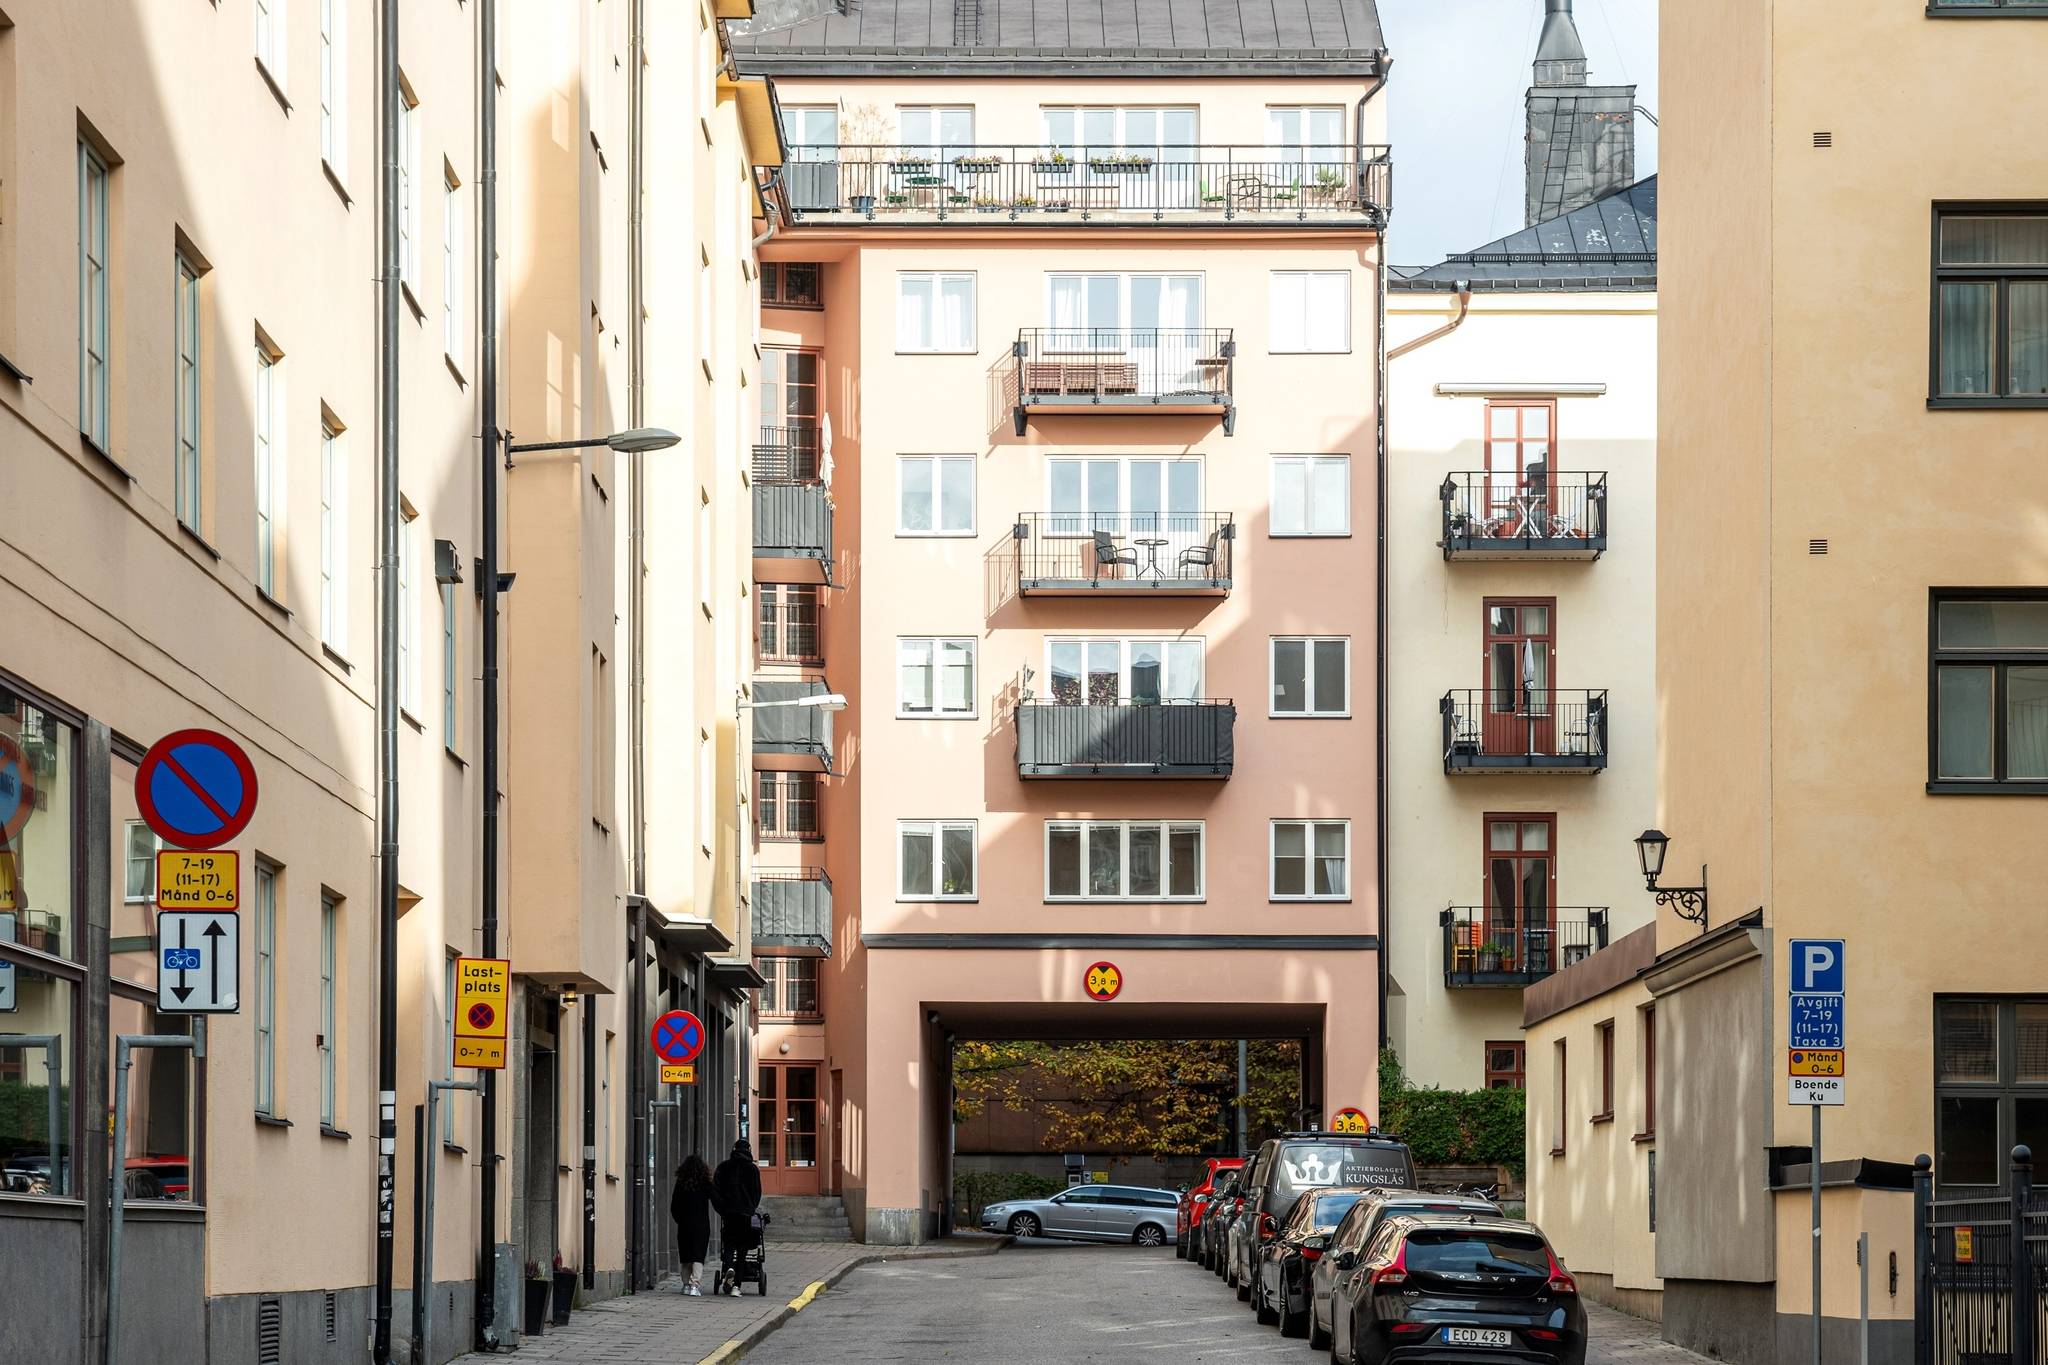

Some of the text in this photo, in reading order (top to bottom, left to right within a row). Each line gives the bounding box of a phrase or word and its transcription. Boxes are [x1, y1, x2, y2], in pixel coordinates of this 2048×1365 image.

[182, 858, 214, 870] 7-19
[176, 873, 220, 886] (11-17)
[161, 889, 235, 901] Månd 0-6
[1805, 945, 1835, 988] P
[1090, 975, 1107, 987] 3,8
[464, 981, 501, 994] plats
[1797, 997, 1839, 1009] Avgift
[1802, 1010, 1833, 1020] 7-19
[1796, 1022, 1838, 1034] (11-17)
[1794, 1036, 1840, 1046] Taxa 3
[460, 1047, 500, 1058] 0-7 m
[1807, 1052, 1838, 1061] Månd
[1811, 1064, 1834, 1073] 0-6
[1795, 1079, 1838, 1089] Boende
[1809, 1091, 1824, 1101] Ku
[1345, 1165, 1404, 1174] AKTIEBOLAGET
[1345, 1173, 1405, 1185] KUNGSLÅS
[1441, 1273, 1516, 1283] VOLVO
[1453, 1329, 1506, 1343] ECD 428
